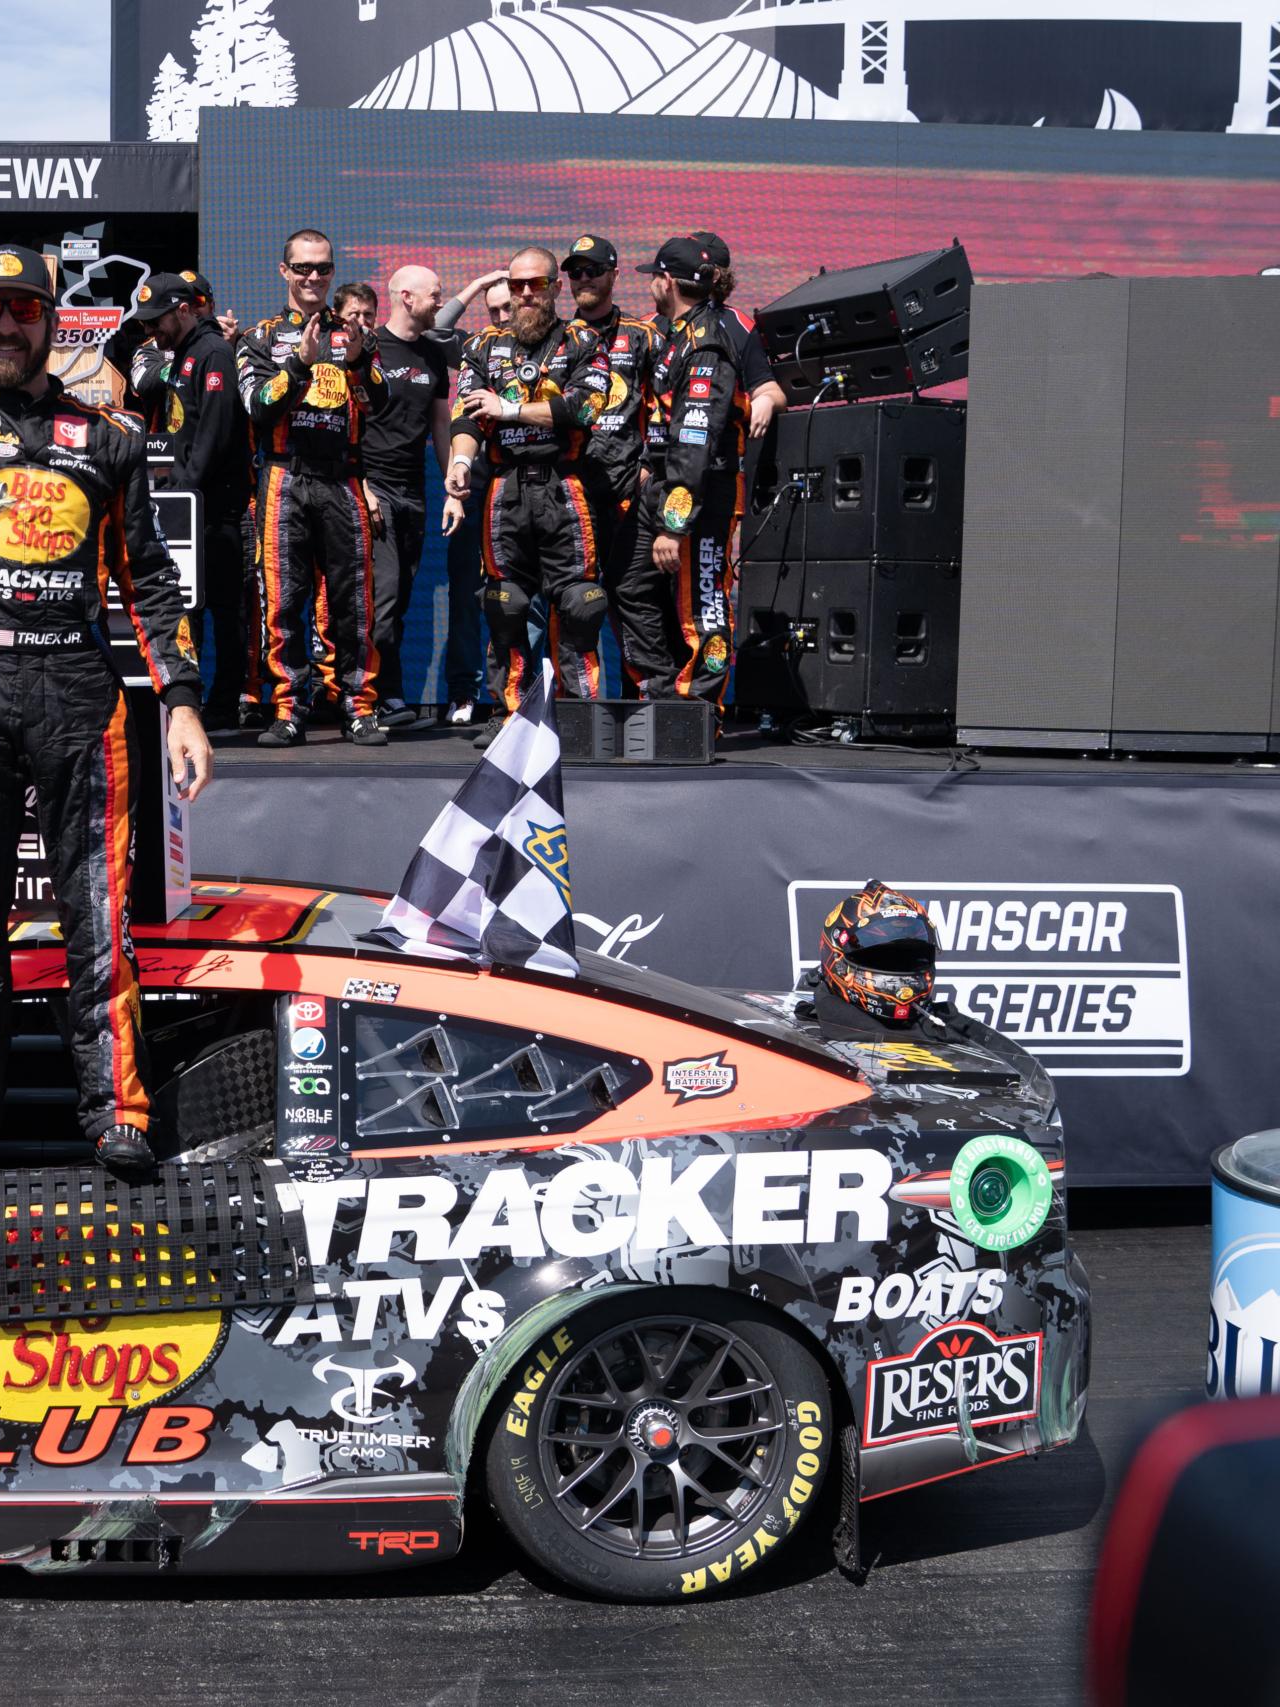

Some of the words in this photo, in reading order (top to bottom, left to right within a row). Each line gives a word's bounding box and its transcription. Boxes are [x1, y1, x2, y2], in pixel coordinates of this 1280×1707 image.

[56, 329, 95, 344] 350
[316, 364, 341, 377] Bass
[700, 366, 714, 376] 75
[317, 376, 336, 389] Pro
[318, 387, 347, 401] Shops
[290, 411, 346, 426] TRACKER
[292, 420, 316, 429] BOATS
[147, 440, 168, 452] nity
[501, 437, 525, 446] BOATS
[49, 458, 97, 475] GOODYEAR
[10, 472, 67, 501] Bass
[11, 498, 53, 523] Pro
[7, 520, 76, 556] Shops
[699, 537, 717, 632] TRACKER
[37, 590, 74, 601] ATVs
[714, 590, 726, 627] BOATS
[17, 632, 61, 645] TRUEX
[63, 632, 82, 644] JR.
[926, 900, 1128, 952] NASCAR
[969, 984, 1136, 1033] SERIES
[284, 1061, 333, 1071] Auto-Owners
[671, 1069, 729, 1077] INTERSTATE
[675, 1078, 727, 1086] BATTERIES
[979, 1111, 1017, 1130] VIPER
[953, 1162, 970, 1185] GET
[966, 1137, 1038, 1171] BIOETHANOL
[275, 1149, 894, 1267] TRACKER
[965, 1216, 986, 1240] GET
[986, 1198, 1049, 1247] BIOETHANOL
[833, 1268, 1008, 1323] BOATS
[273, 1275, 506, 1347] ATVs
[3, 1331, 180, 1401] Shops
[506, 1326, 574, 1438] EAGLE
[880, 1345, 1029, 1433] RESER'S
[916, 1407, 944, 1421] FINE
[297, 1429, 431, 1449] TRUETIMBER
[338, 1446, 386, 1458] CAMO
[681, 1400, 823, 1594] GOODYEAR
[349, 1531, 440, 1556] TRD
